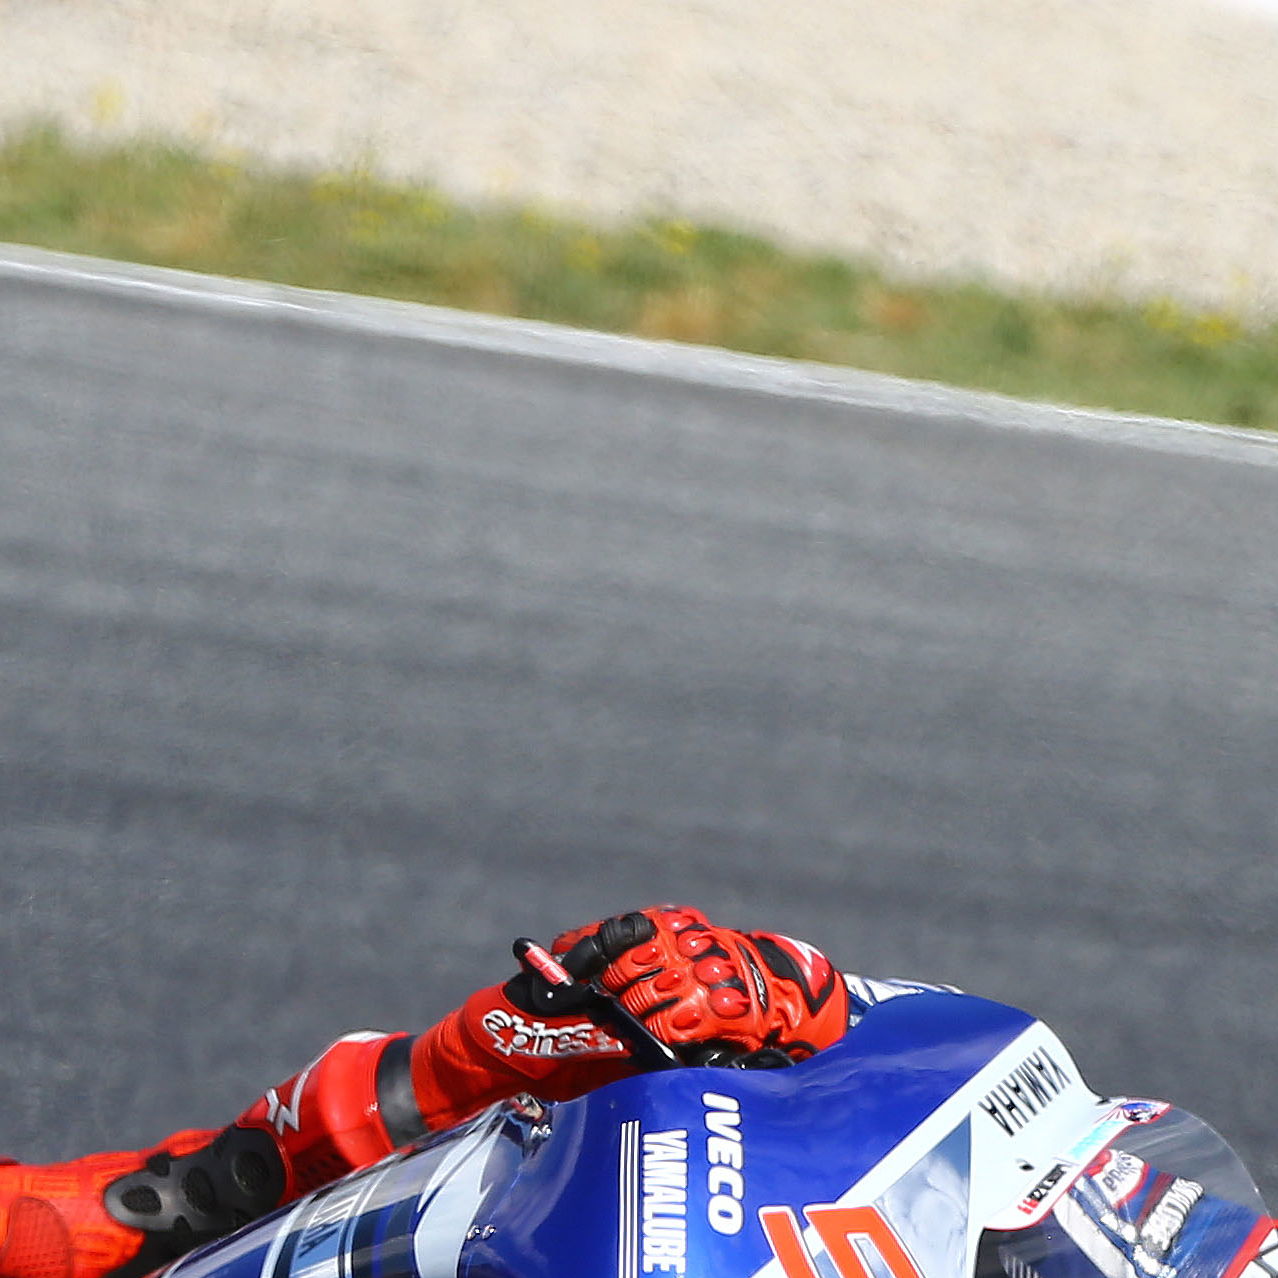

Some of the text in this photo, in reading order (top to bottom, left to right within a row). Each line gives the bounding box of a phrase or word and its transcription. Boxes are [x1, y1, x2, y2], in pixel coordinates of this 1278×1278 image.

[978, 1046, 1071, 1137] YAMAHA
[642, 1129, 688, 1275] YAMALUBE
[702, 1092, 745, 1236] IVECO
